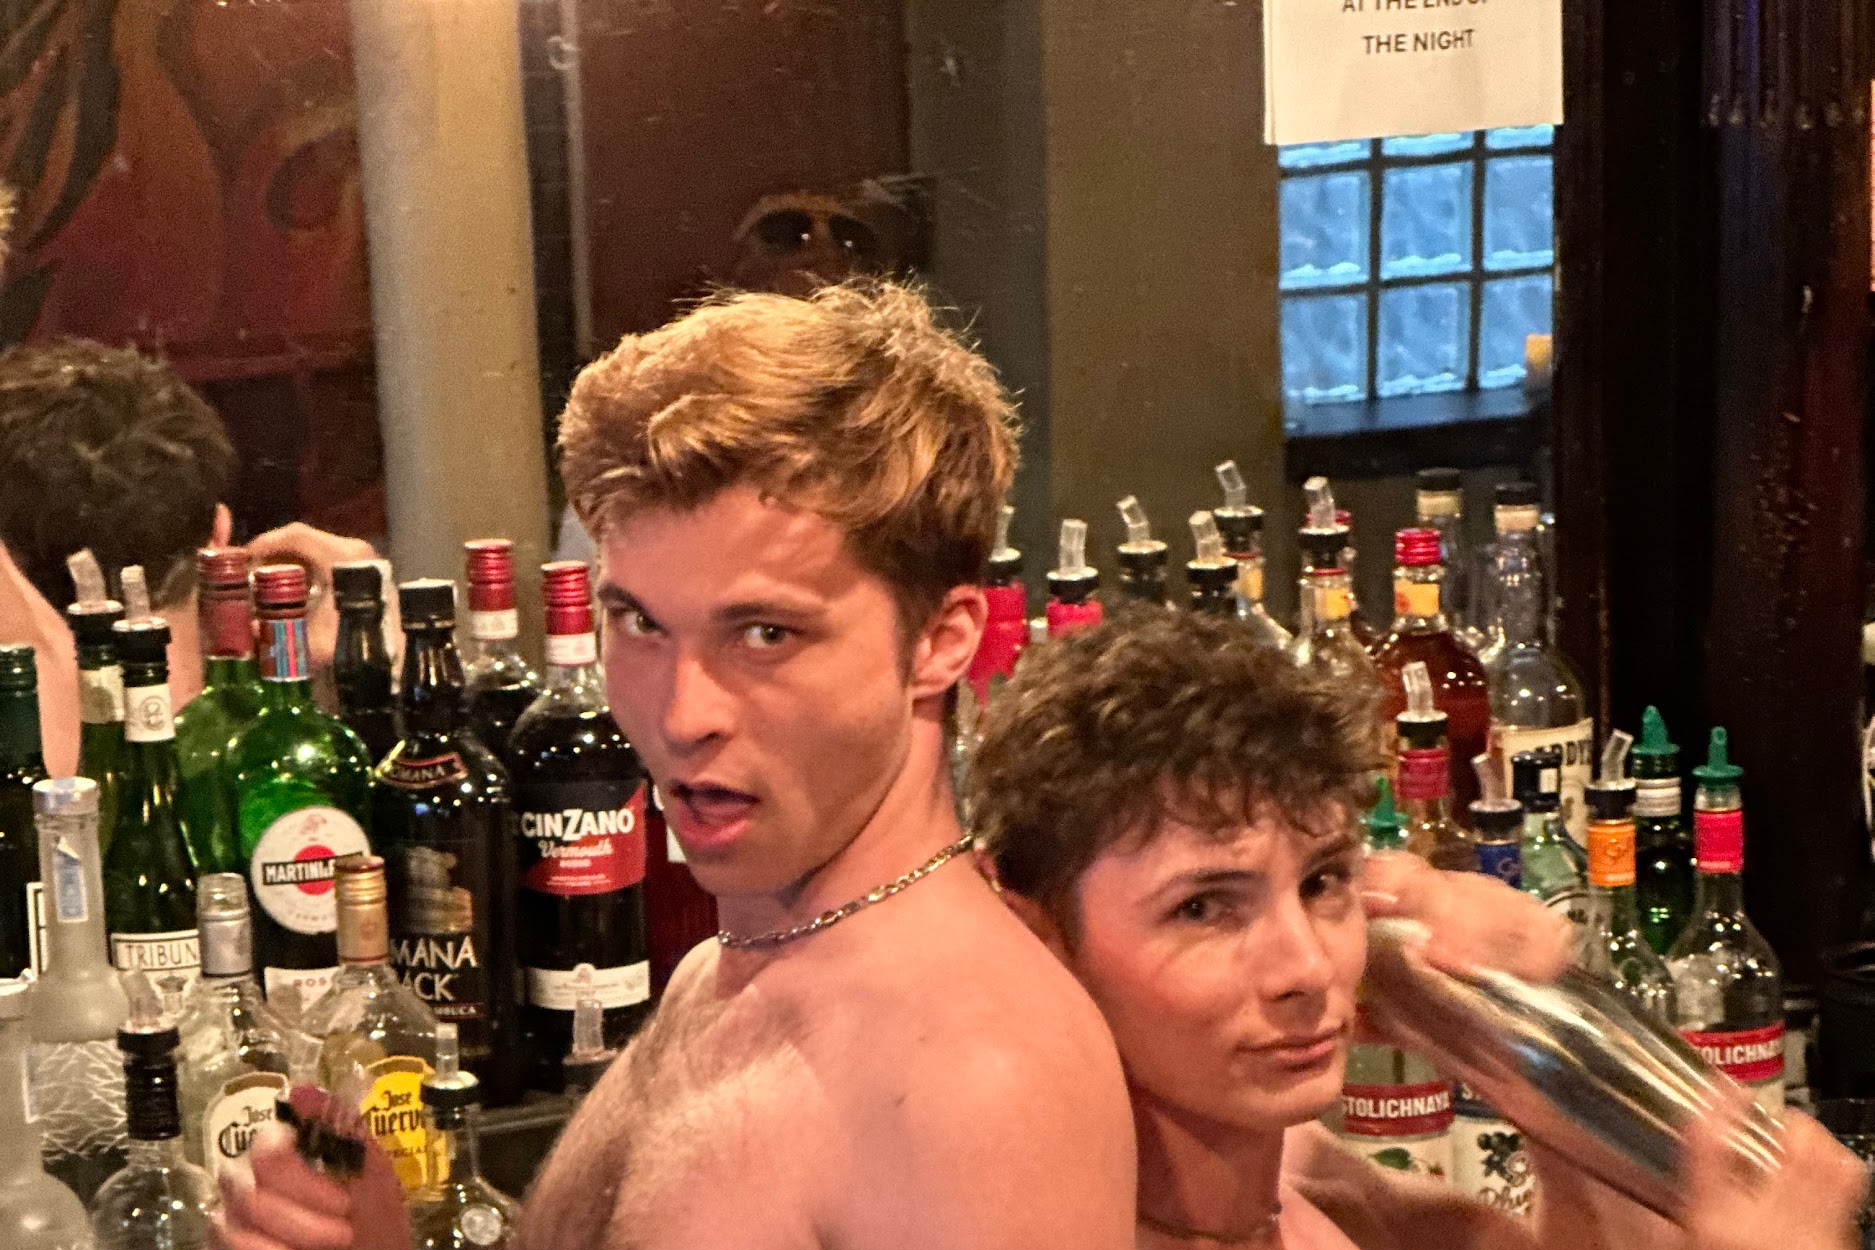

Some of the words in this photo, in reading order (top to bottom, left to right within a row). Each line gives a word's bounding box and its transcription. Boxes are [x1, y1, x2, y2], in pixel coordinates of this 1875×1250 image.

[1363, 34, 1407, 54] THE
[1413, 29, 1474, 51] NIGHT
[521, 808, 635, 841] CINZANO
[264, 861, 324, 883] MARTINI
[125, 943, 198, 967] TRIBUN
[389, 935, 477, 969] MANA
[403, 970, 459, 1001] ACK
[381, 1090, 412, 1111] Jose
[242, 1106, 273, 1127] Jose
